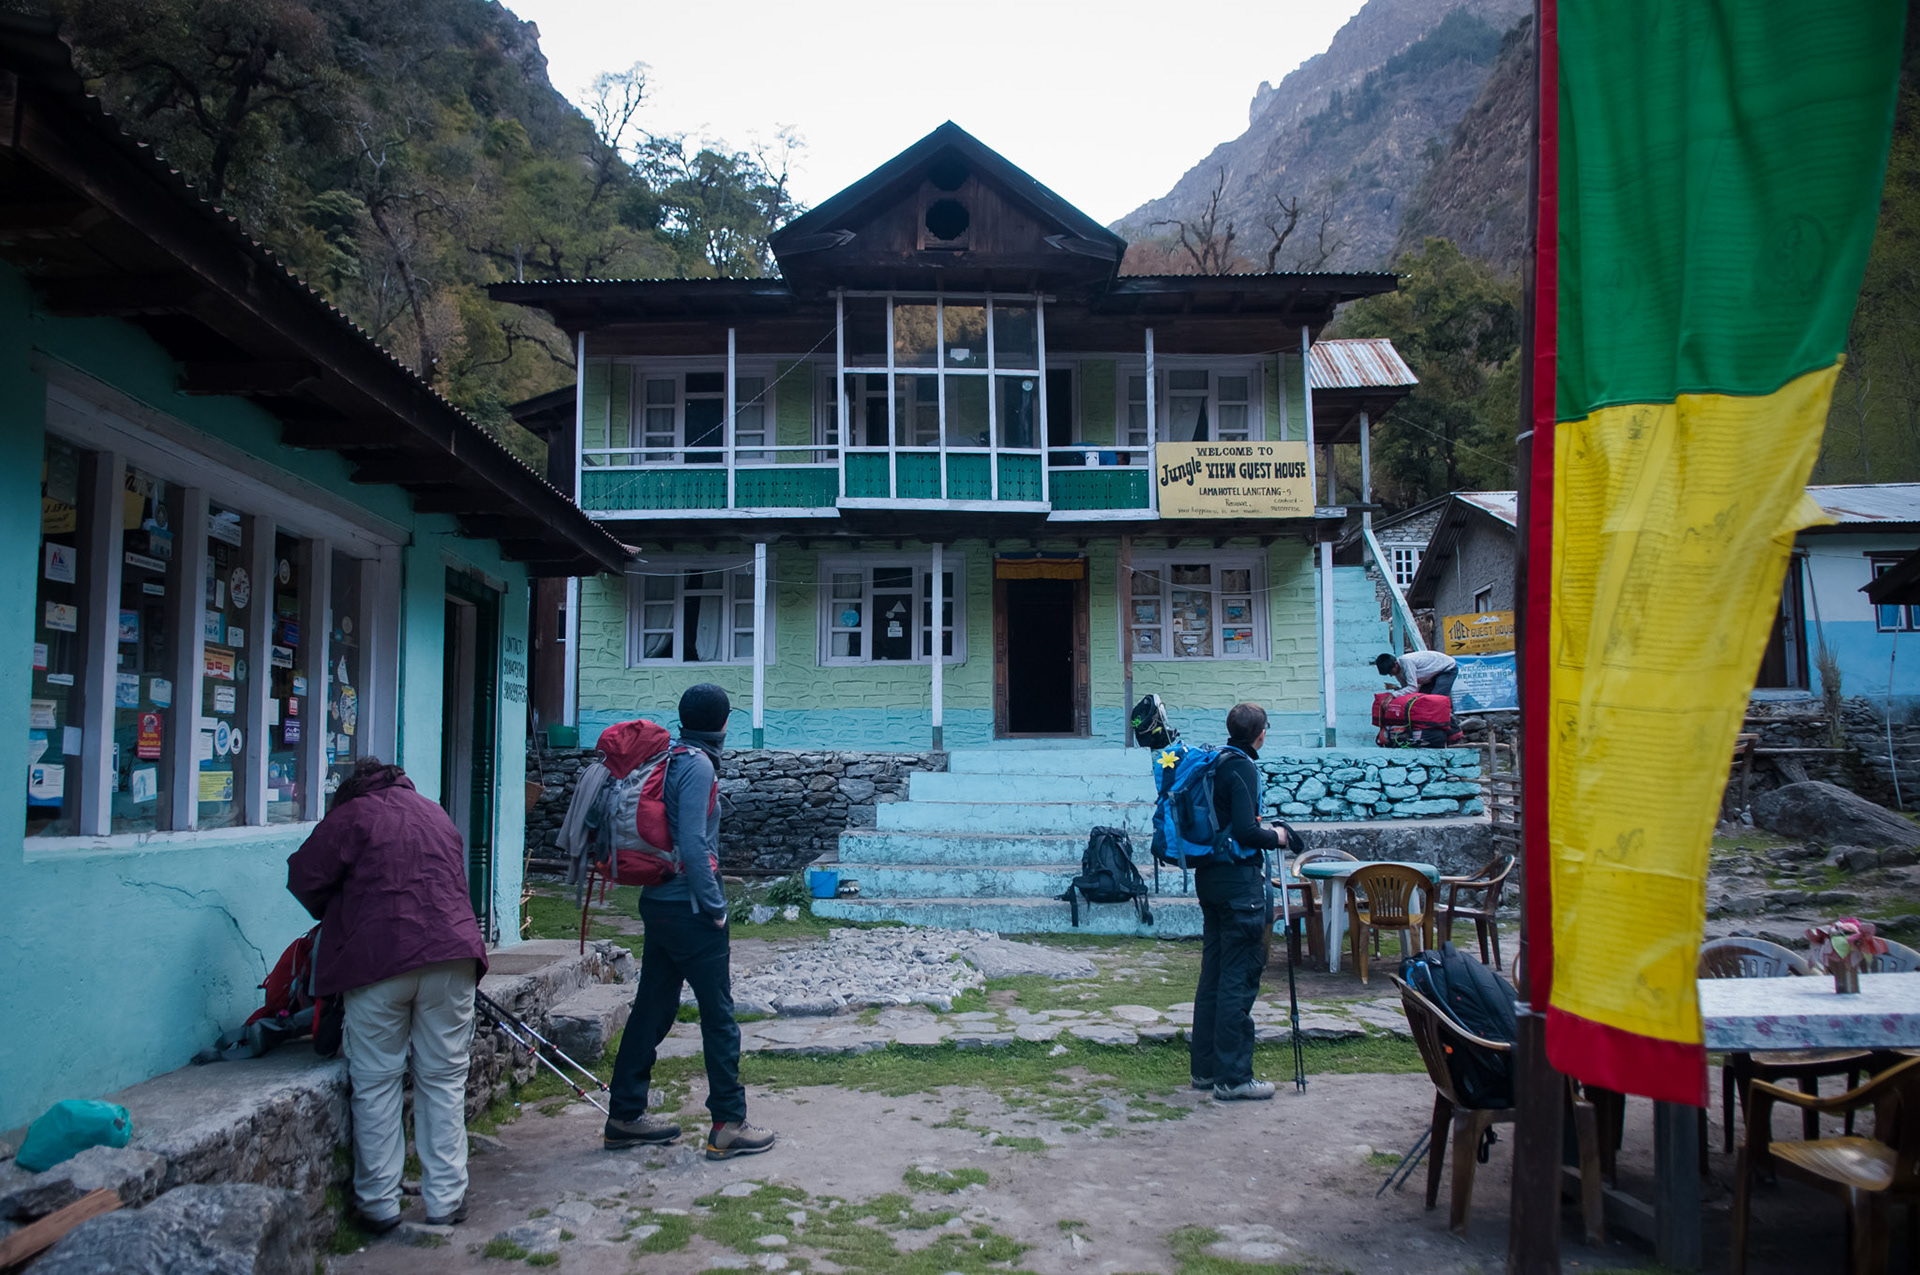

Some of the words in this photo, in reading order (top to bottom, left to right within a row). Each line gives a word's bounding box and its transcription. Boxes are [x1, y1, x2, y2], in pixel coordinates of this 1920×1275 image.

[1196, 447, 1253, 456] WELCOME
[1258, 447, 1273, 455] TO
[1160, 457, 1202, 486] Jungle
[1205, 462, 1236, 478] VIEW
[1239, 462, 1272, 480] GUEST
[1274, 462, 1306, 478] HOUSE
[1448, 620, 1470, 640] TIBET
[1471, 626, 1493, 638] GUEST
[1495, 624, 1514, 636] HOUS
[1461, 664, 1497, 672] WELCOME
